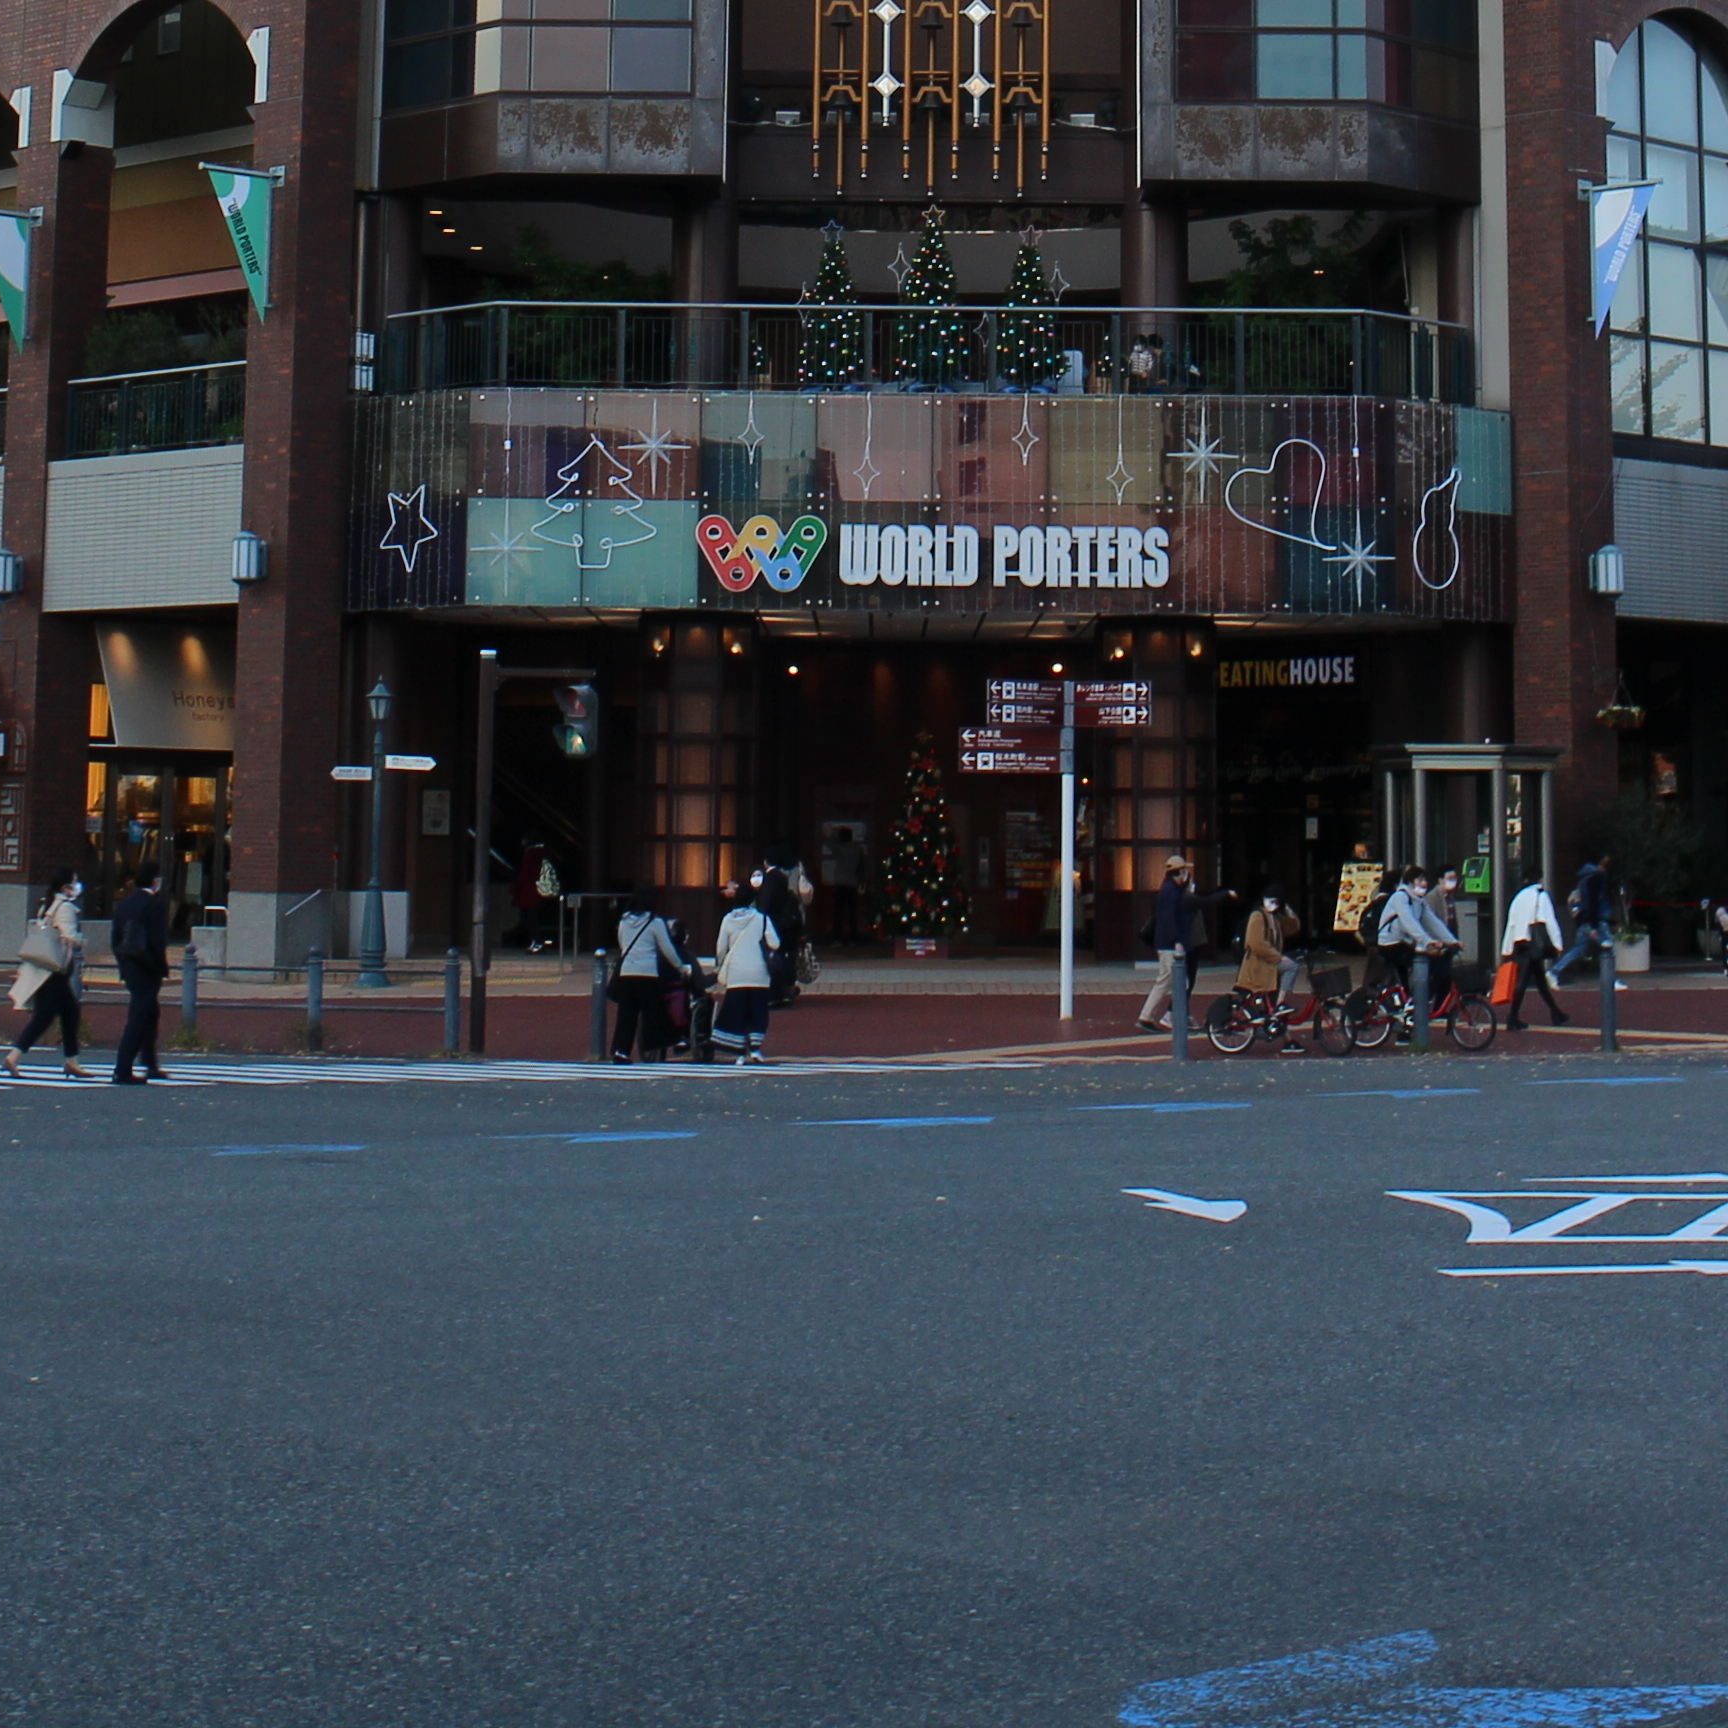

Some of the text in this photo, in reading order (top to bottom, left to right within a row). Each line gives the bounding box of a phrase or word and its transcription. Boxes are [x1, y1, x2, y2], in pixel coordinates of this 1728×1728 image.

[838, 523, 1169, 588] WORLD PORTERS
[173, 689, 236, 710] Honeys
[193, 711, 224, 722] factory
